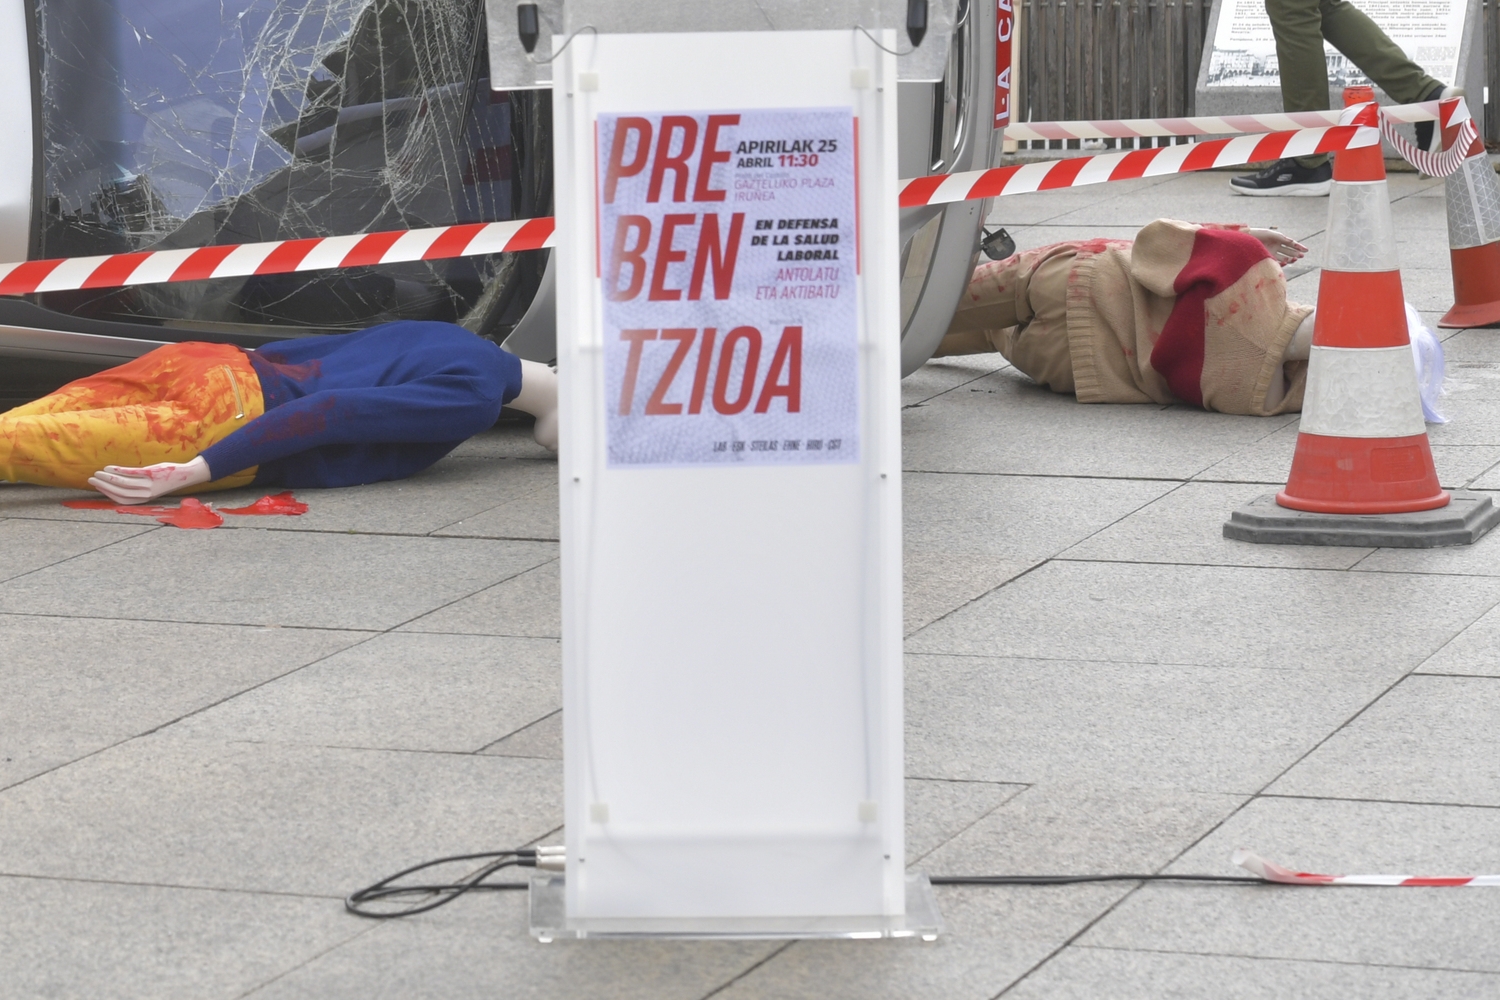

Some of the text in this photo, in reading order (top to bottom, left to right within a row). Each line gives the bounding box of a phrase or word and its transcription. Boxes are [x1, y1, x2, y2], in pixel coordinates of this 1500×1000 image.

[996, 66, 1011, 120] LA
[736, 139, 838, 155] APIRILAK 25
[603, 114, 741, 205] PRE
[736, 153, 819, 168] ABRIL 11:30
[734, 177, 836, 191] GAZTELUKO PLAZA
[755, 218, 839, 230] EN DEFENSA
[750, 233, 840, 246] DE LA SALUD
[608, 212, 745, 303] BEN
[777, 249, 840, 262] LABORAL
[775, 266, 839, 282] ANTOLATU
[755, 284, 840, 300] ETA AKTIBATU
[618, 325, 803, 417] TZIOA
